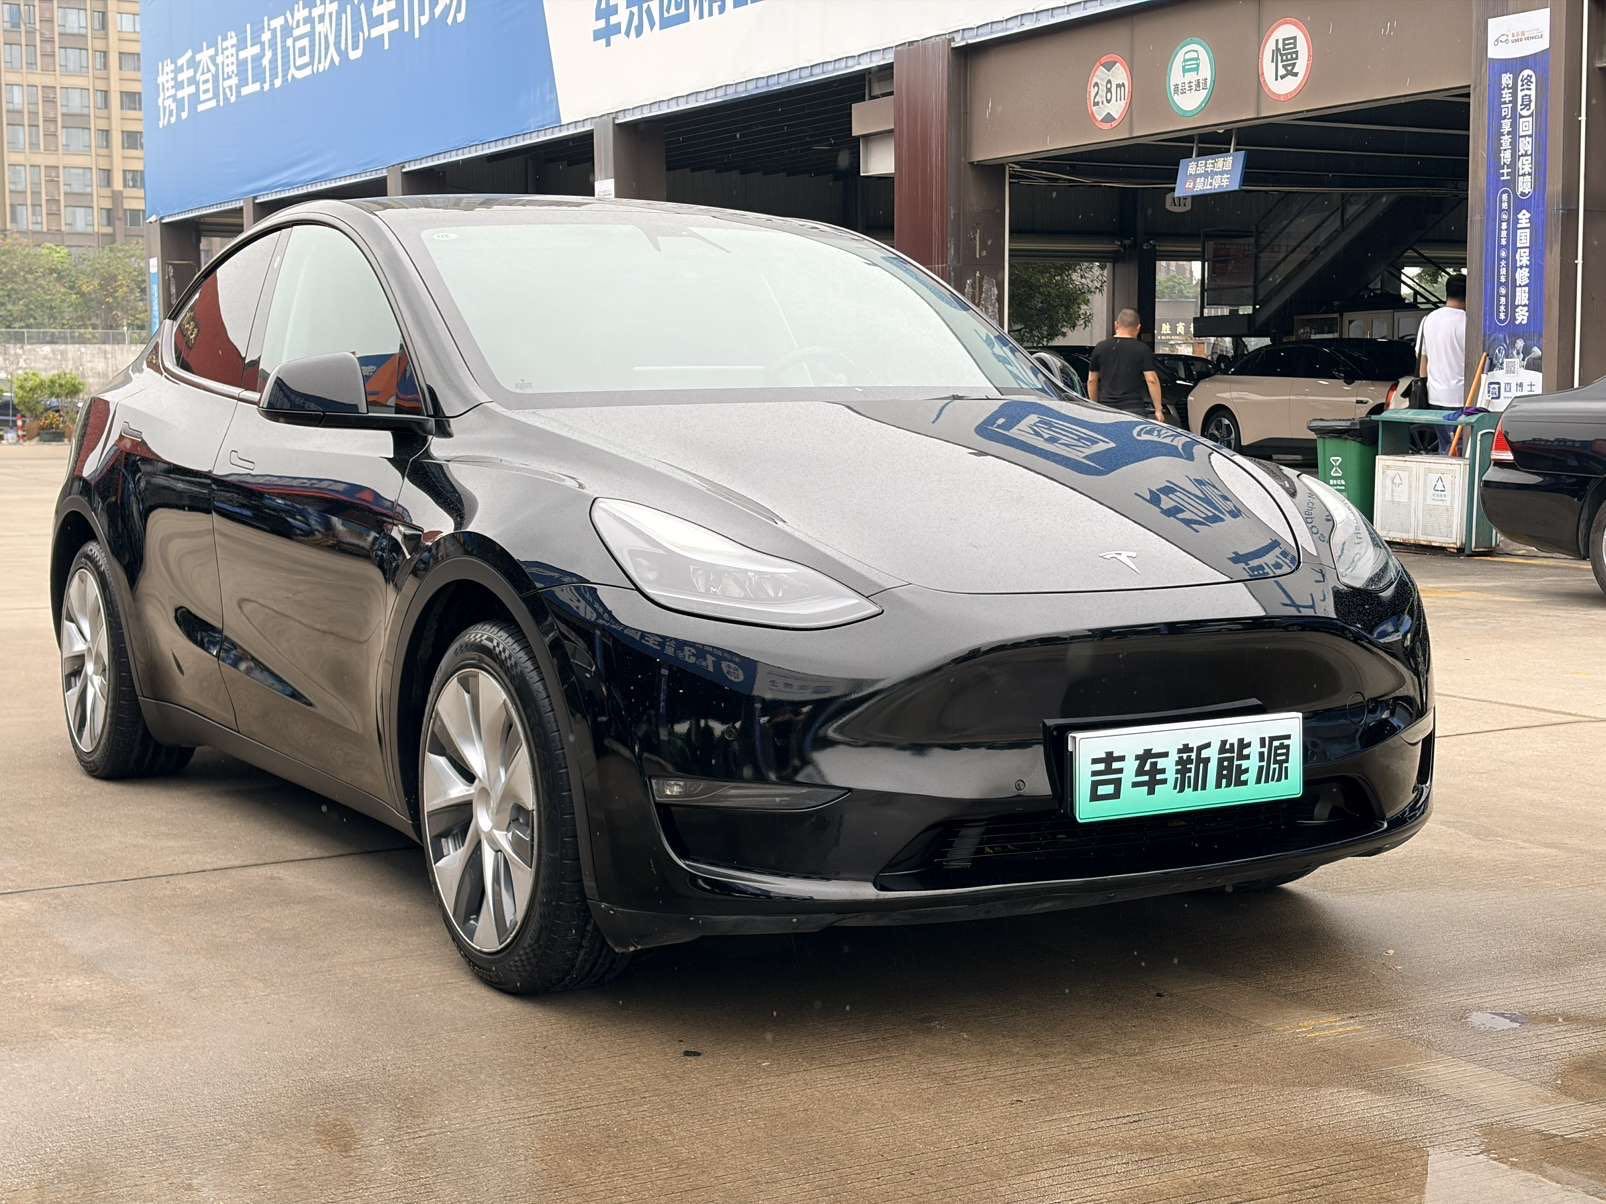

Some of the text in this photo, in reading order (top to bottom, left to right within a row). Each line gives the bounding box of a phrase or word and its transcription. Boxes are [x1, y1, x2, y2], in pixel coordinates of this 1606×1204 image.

[1172, 78, 1209, 96] 商品车通道
[1271, 36, 1300, 81] 慢
[1500, 72, 1513, 181] 购车可享查博士
[1518, 74, 1533, 196] 终身回购保障
[1187, 156, 1232, 176] 商品车通道
[1194, 175, 1230, 191] 禁止停车
[1515, 209, 1531, 325] 全国保修服务
[1088, 734, 1292, 803] 吉车新能源
